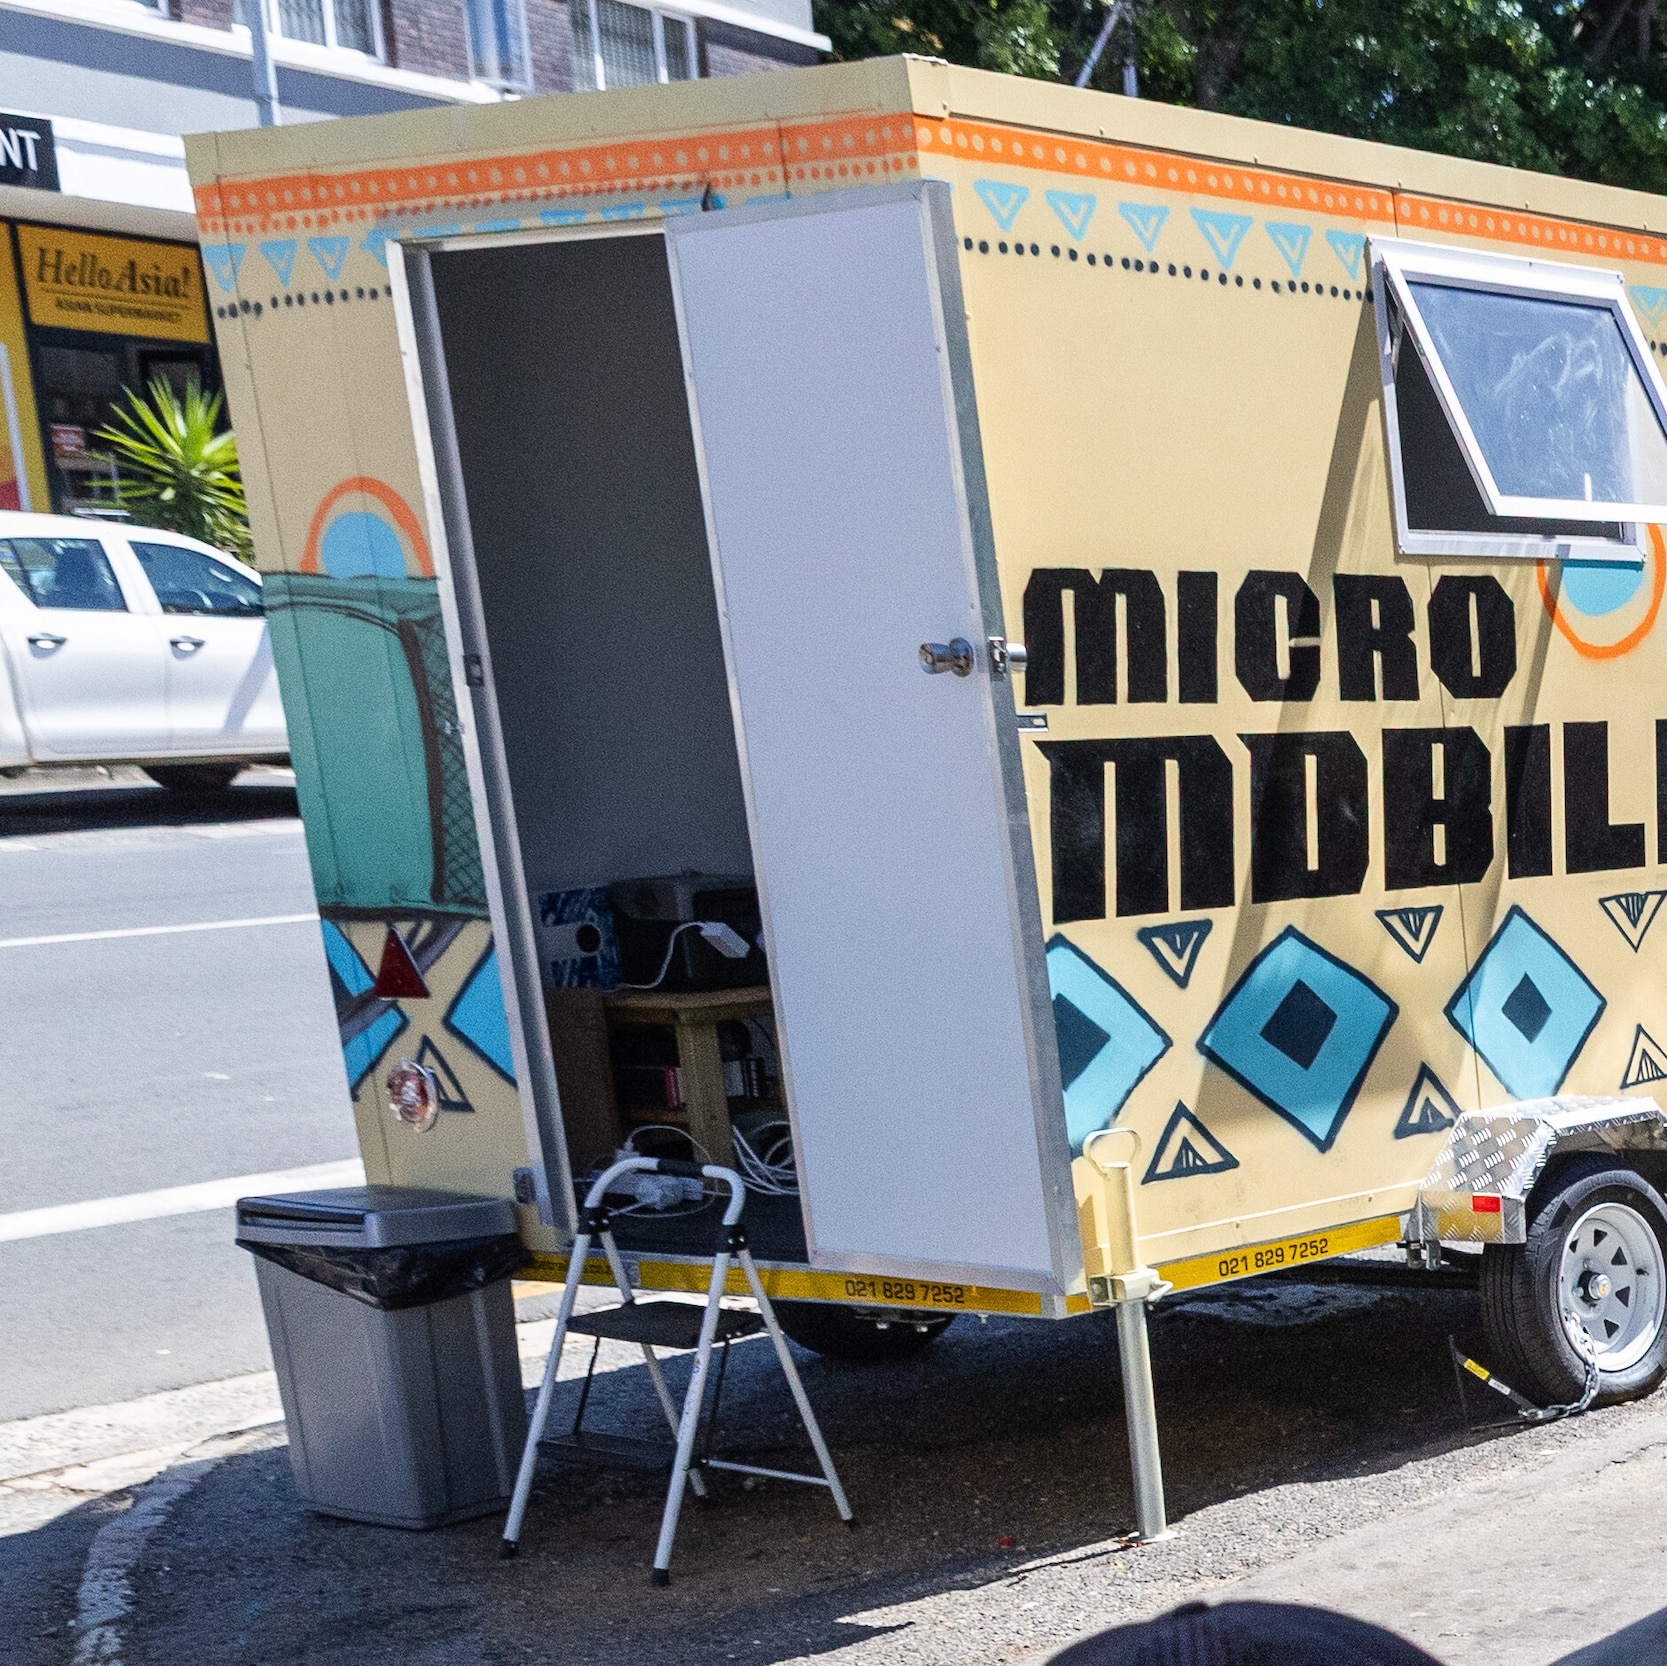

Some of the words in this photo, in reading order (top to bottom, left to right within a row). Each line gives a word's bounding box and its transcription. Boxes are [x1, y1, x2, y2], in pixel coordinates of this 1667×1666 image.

[36, 247, 113, 289] Hello
[115, 258, 191, 298] Asia!
[1022, 568, 1518, 706] MICRO
[1219, 1255, 1249, 1276] 021
[1254, 1247, 1285, 1268] 829
[1288, 1238, 1329, 1261] 7252
[844, 1279, 876, 1297] 021
[882, 1281, 916, 1300] 829
[919, 1284, 965, 1304] 7252
